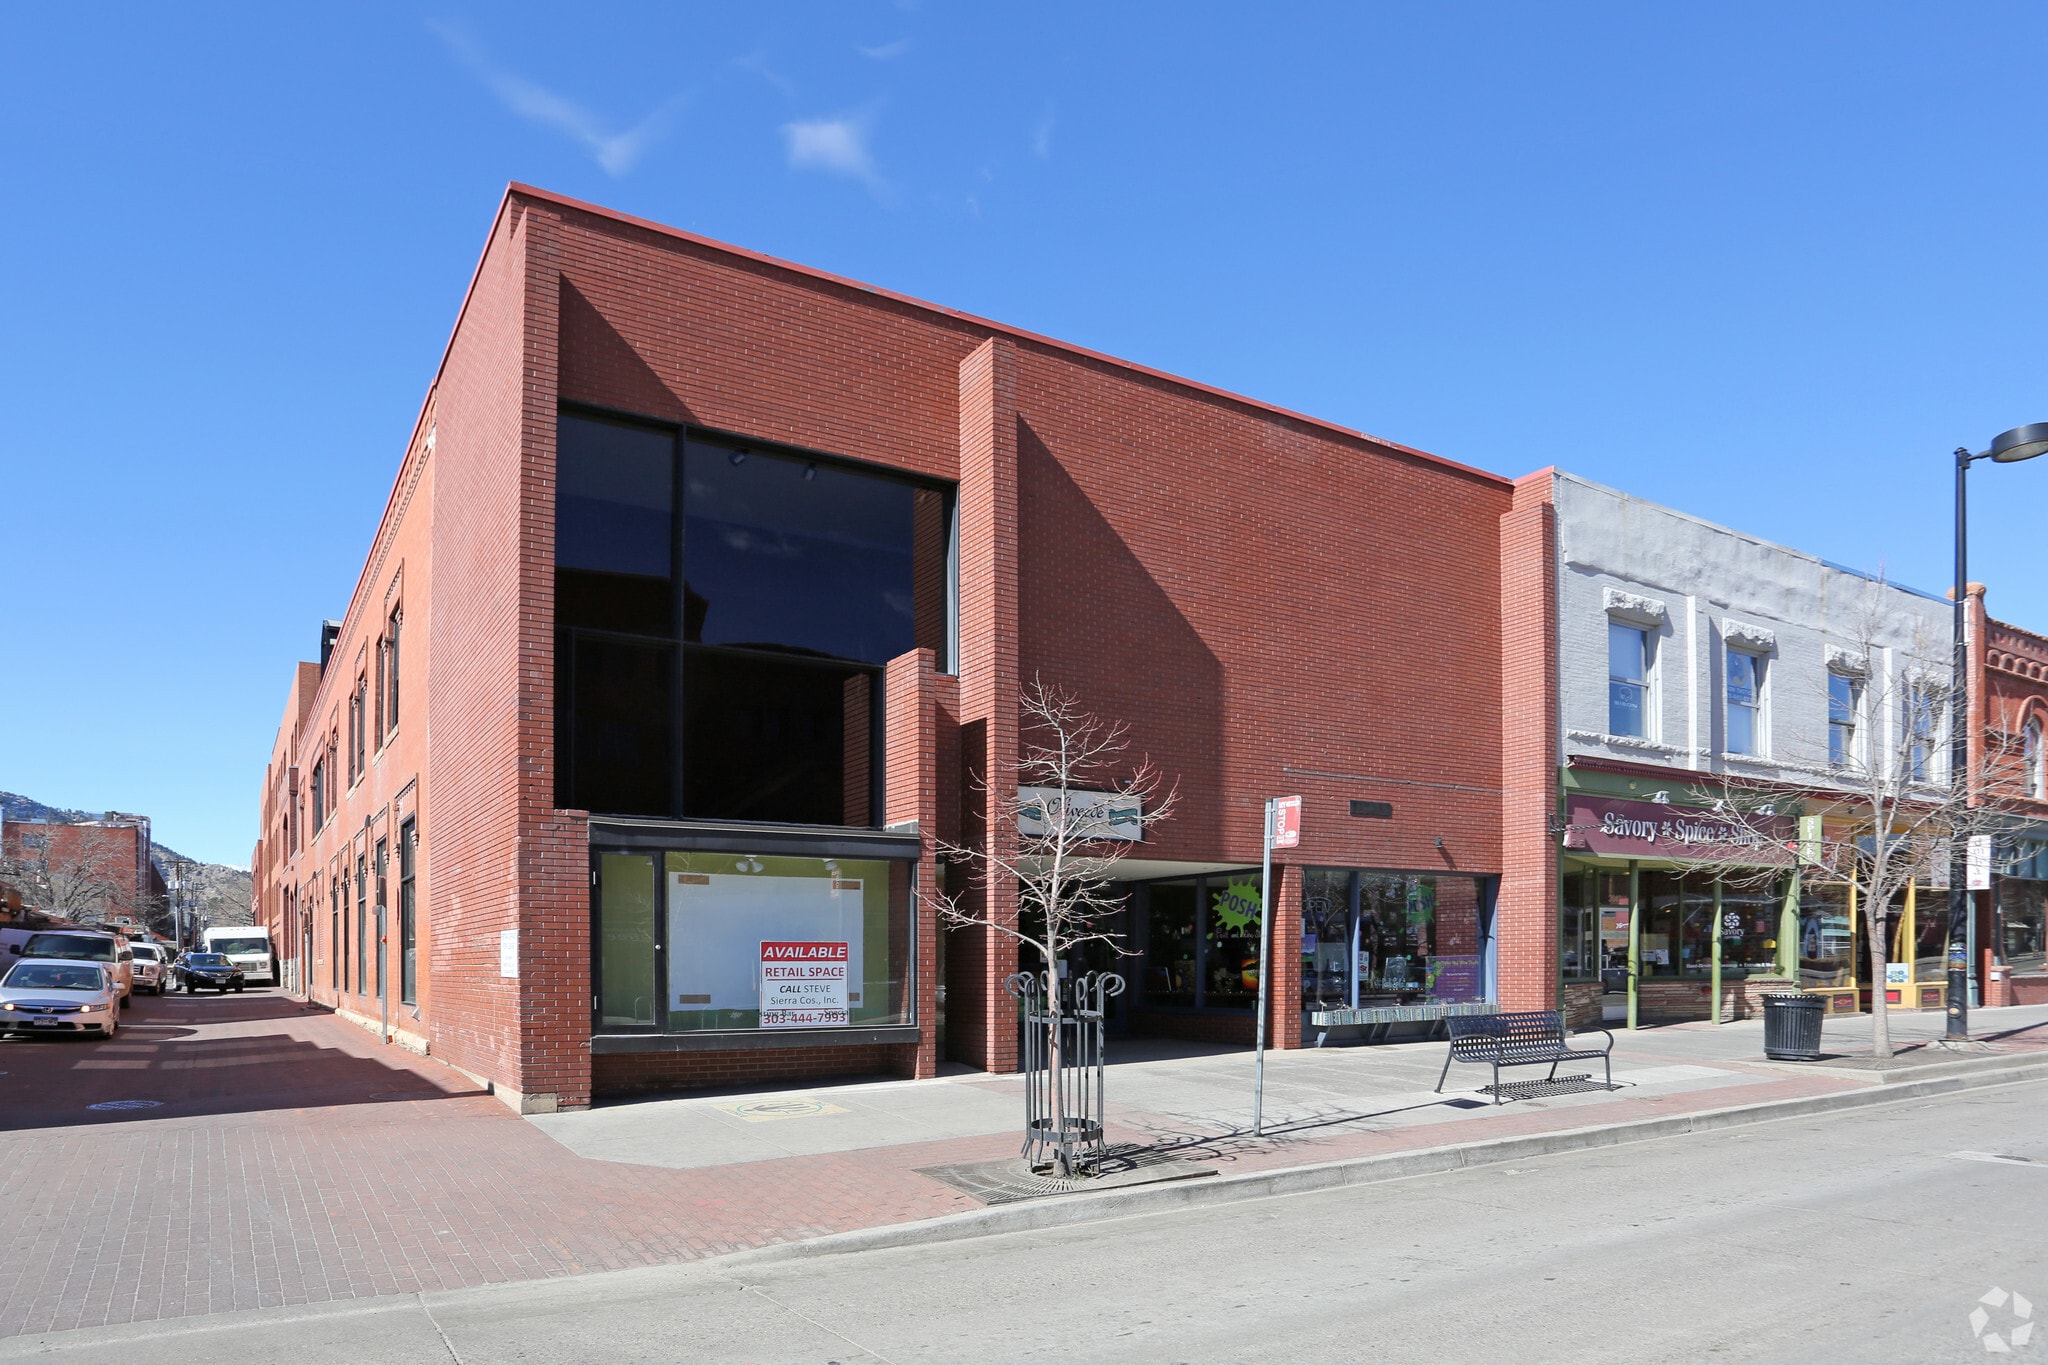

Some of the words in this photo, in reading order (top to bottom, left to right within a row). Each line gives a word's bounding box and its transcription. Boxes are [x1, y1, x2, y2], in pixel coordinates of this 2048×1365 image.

[1277, 809, 1287, 835] STOP
[1603, 811, 1657, 842] Savory
[1675, 818, 1714, 845] Spice
[1220, 891, 1258, 919] POSH
[763, 946, 847, 958] AVAILABLE
[765, 967, 806, 977] RETAIL
[808, 967, 845, 977] SPACE
[779, 985, 801, 993] CALL
[803, 984, 831, 993] STEVE
[770, 996, 797, 1005] Sierra
[800, 996, 821, 1005] Cos.,
[823, 996, 839, 1004] Inc.
[763, 1012, 846, 1024] 303-444-7993
